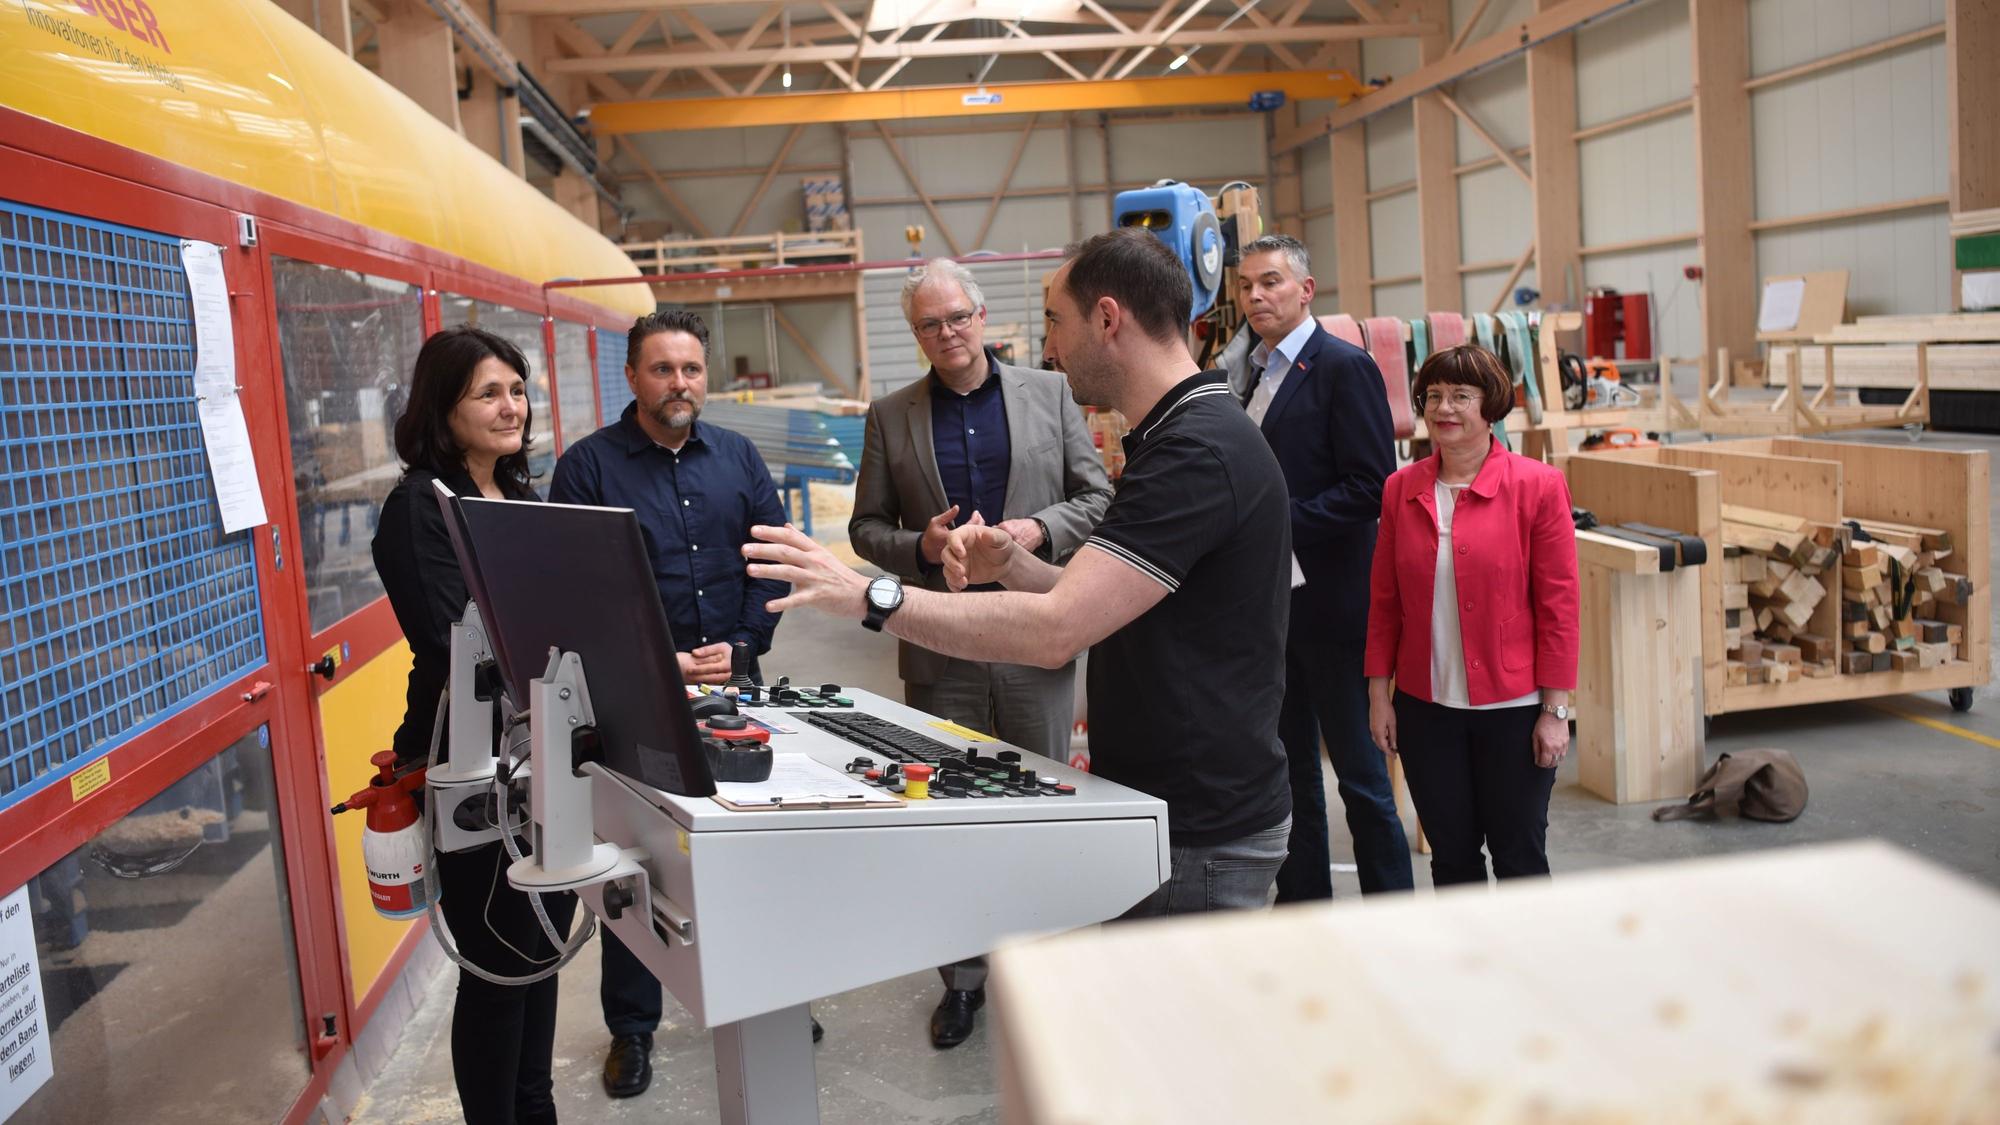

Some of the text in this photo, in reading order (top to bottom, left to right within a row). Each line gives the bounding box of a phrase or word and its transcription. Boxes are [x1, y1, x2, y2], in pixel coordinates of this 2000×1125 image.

[21, 0, 107, 57] Innovationen
[103, 36, 125, 65] für
[5, 903, 20, 920] den
[24, 994, 37, 1016] auf
[0, 1019, 38, 1061] dem Band
[9, 1046, 36, 1080] liegen!
